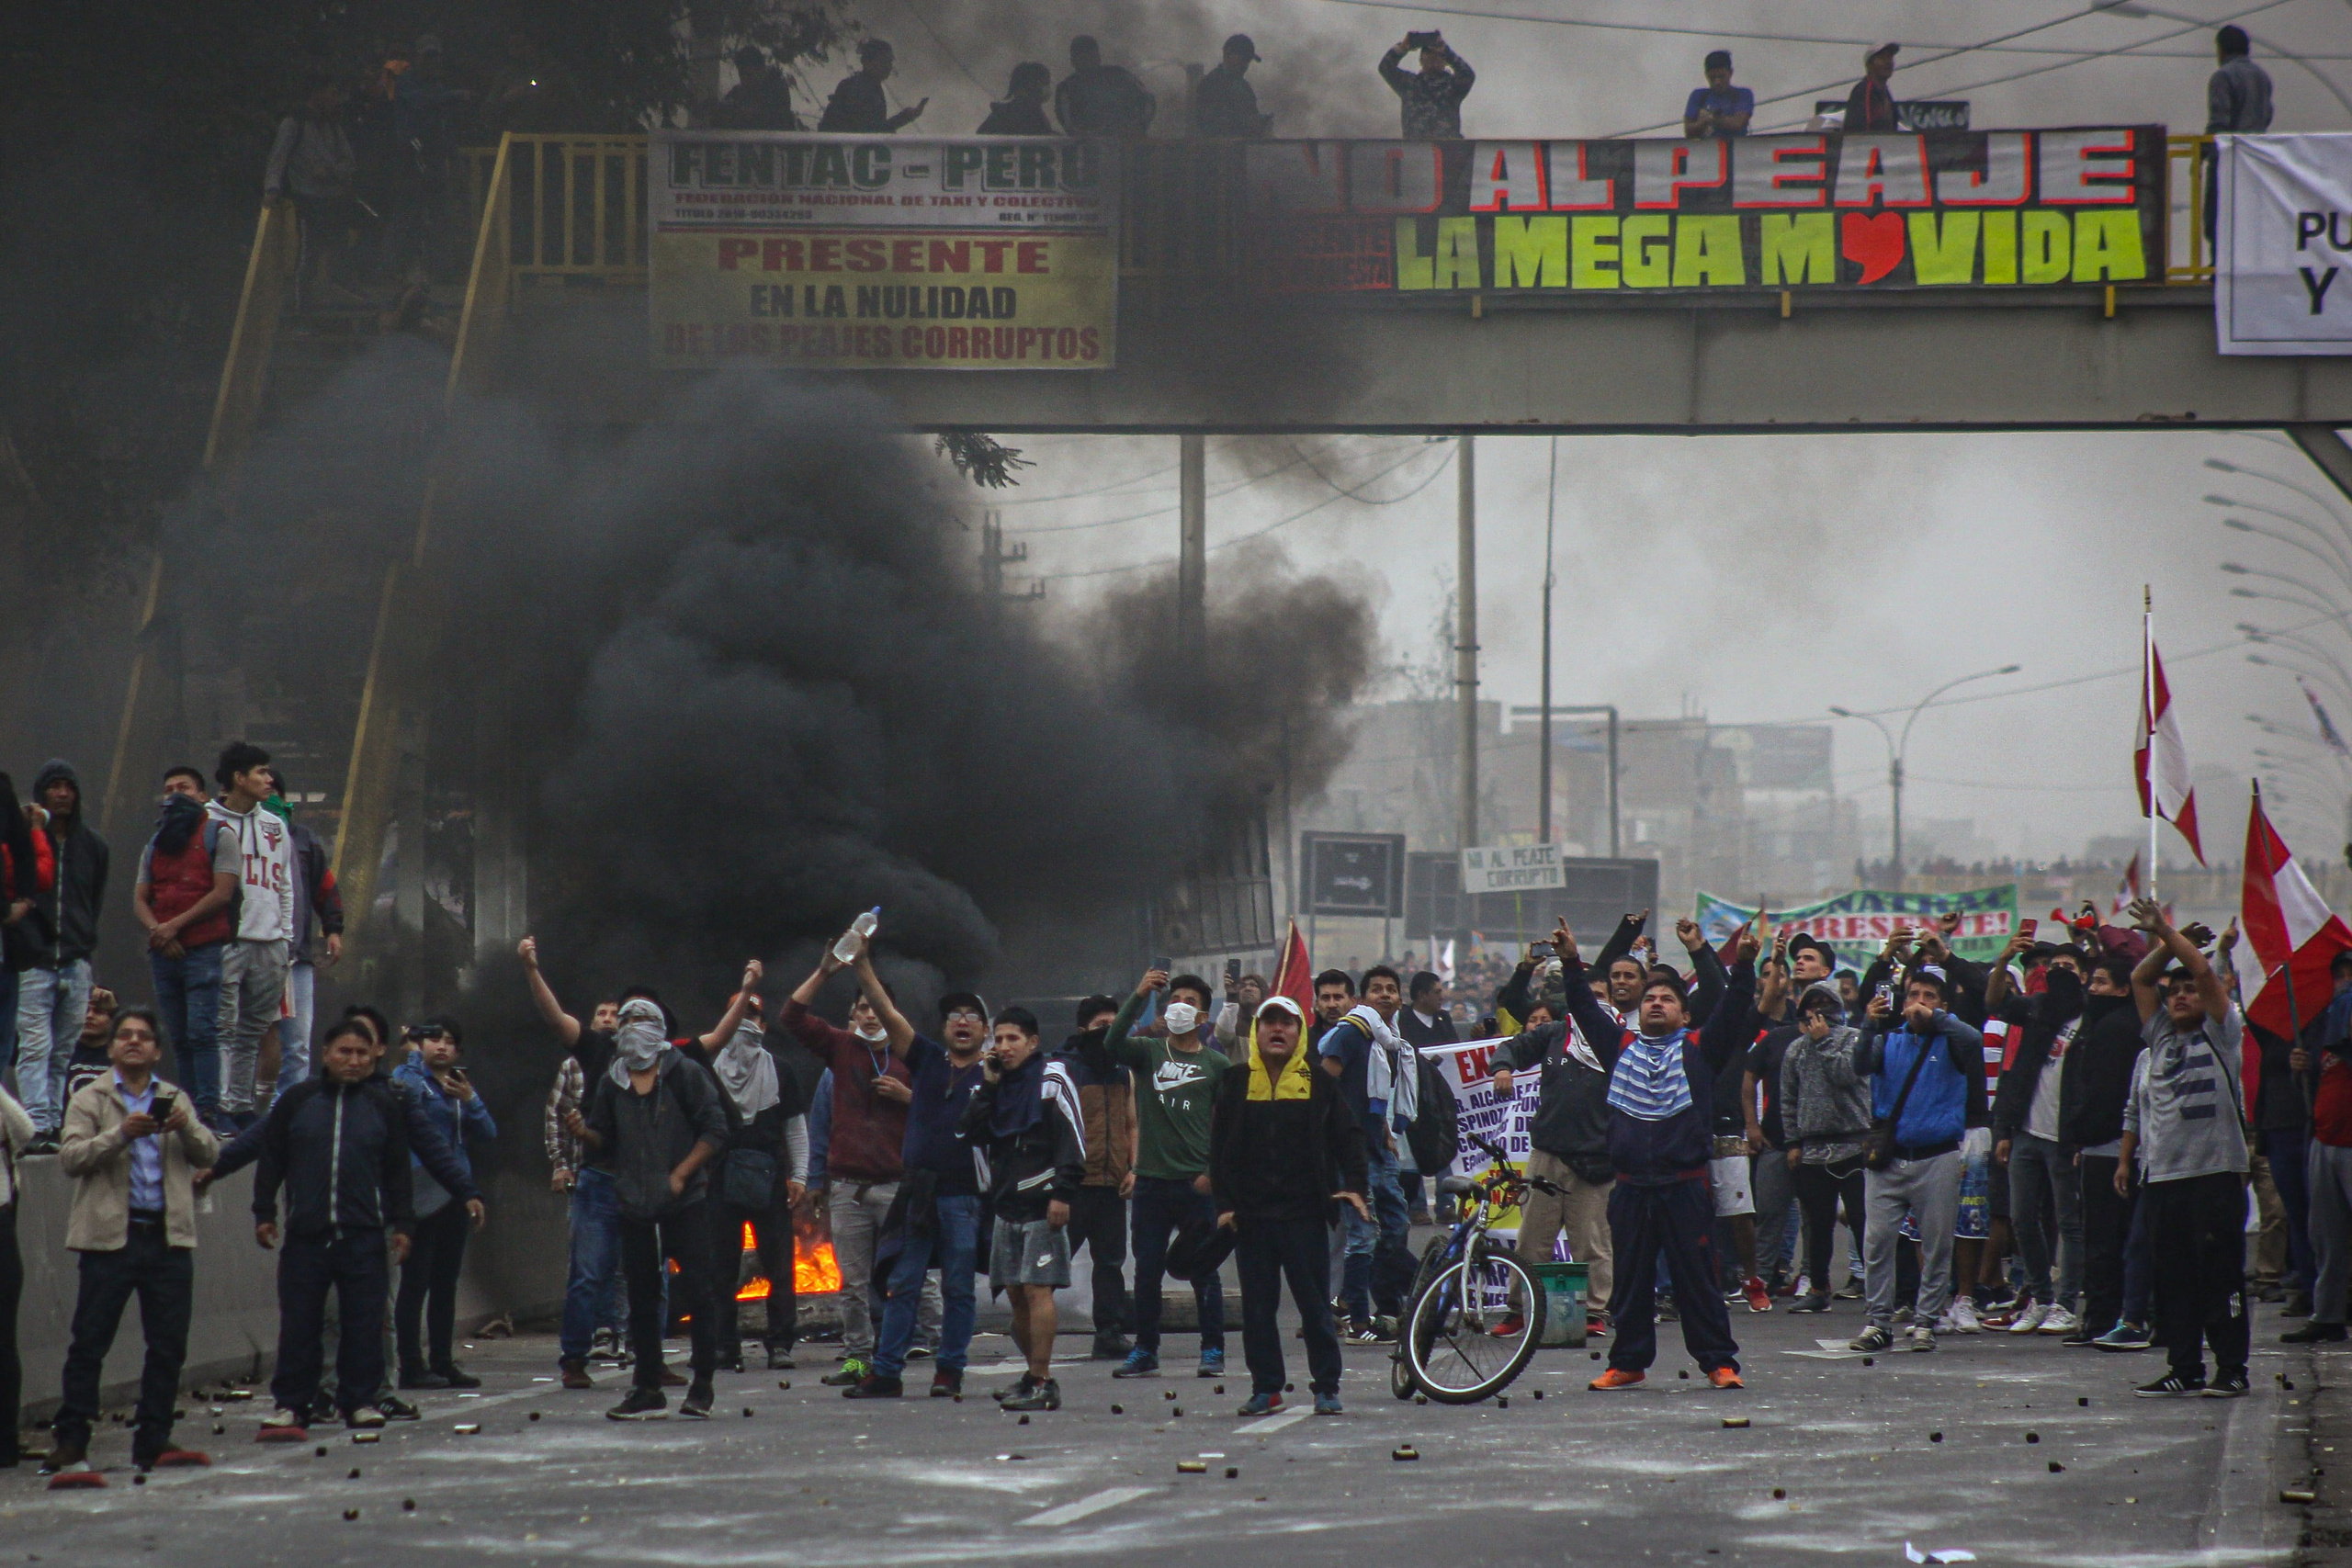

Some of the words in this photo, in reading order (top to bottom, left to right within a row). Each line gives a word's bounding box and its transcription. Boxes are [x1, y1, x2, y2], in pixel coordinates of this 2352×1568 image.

[669, 142, 892, 190] FENTAC
[1245, 140, 1442, 212] NO
[1470, 141, 1614, 211] AL
[1634, 130, 2134, 209] PEAJE
[799, 194, 896, 207] NACIONAL
[901, 196, 924, 207] DE
[930, 196, 972, 208] TAXI
[977, 197, 988, 208] Y
[718, 237, 1049, 274] PRESENTE
[1396, 216, 1481, 290] LA
[1494, 214, 1746, 289] MEGA
[750, 285, 794, 318] EN
[805, 285, 848, 318] LA
[856, 285, 1016, 320] NULIDAD
[2298, 267, 2339, 315] Y
[780, 324, 893, 357] PEAJES
[901, 325, 1100, 361] CORRUPTOS
[243, 853, 290, 893] LLS
[1158, 1093, 1191, 1111] AIR
